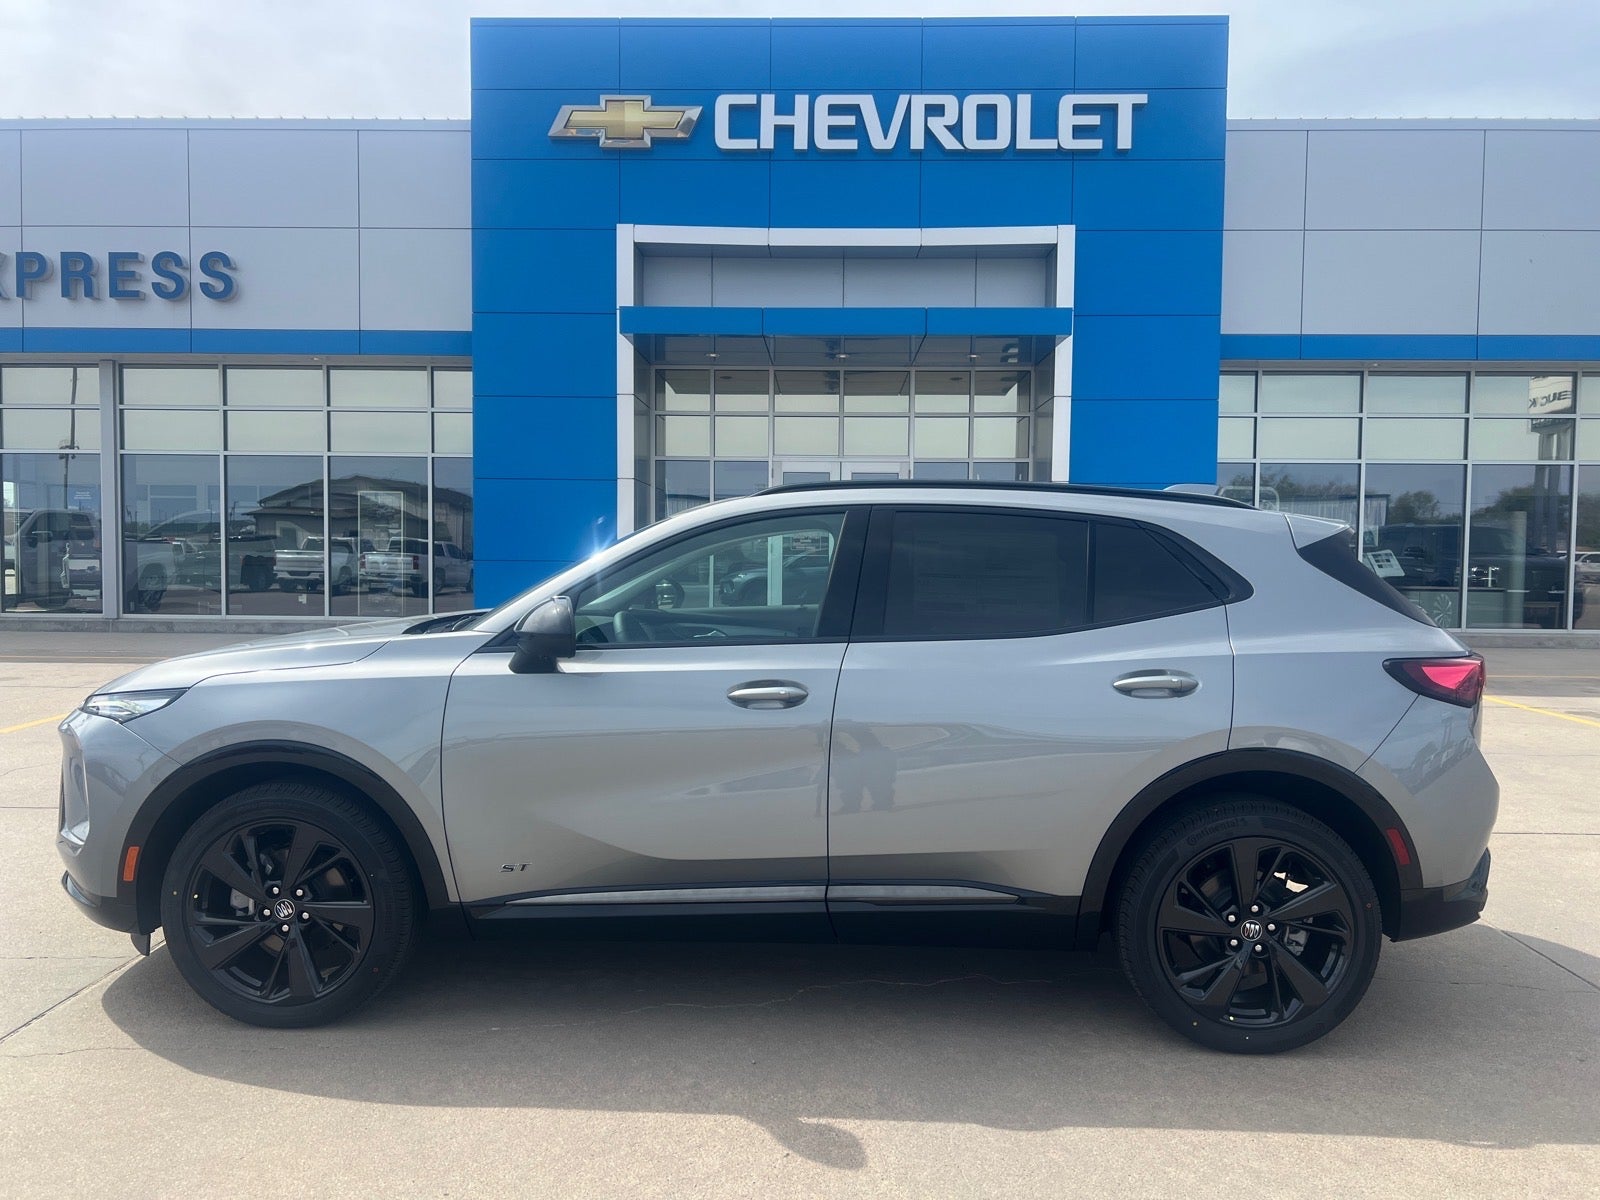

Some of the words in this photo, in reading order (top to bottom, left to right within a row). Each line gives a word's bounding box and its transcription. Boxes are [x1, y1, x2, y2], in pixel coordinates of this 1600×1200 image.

[713, 92, 1148, 151] CHEVROLET
[0, 250, 238, 300] PRESS
[498, 862, 533, 873] ST
